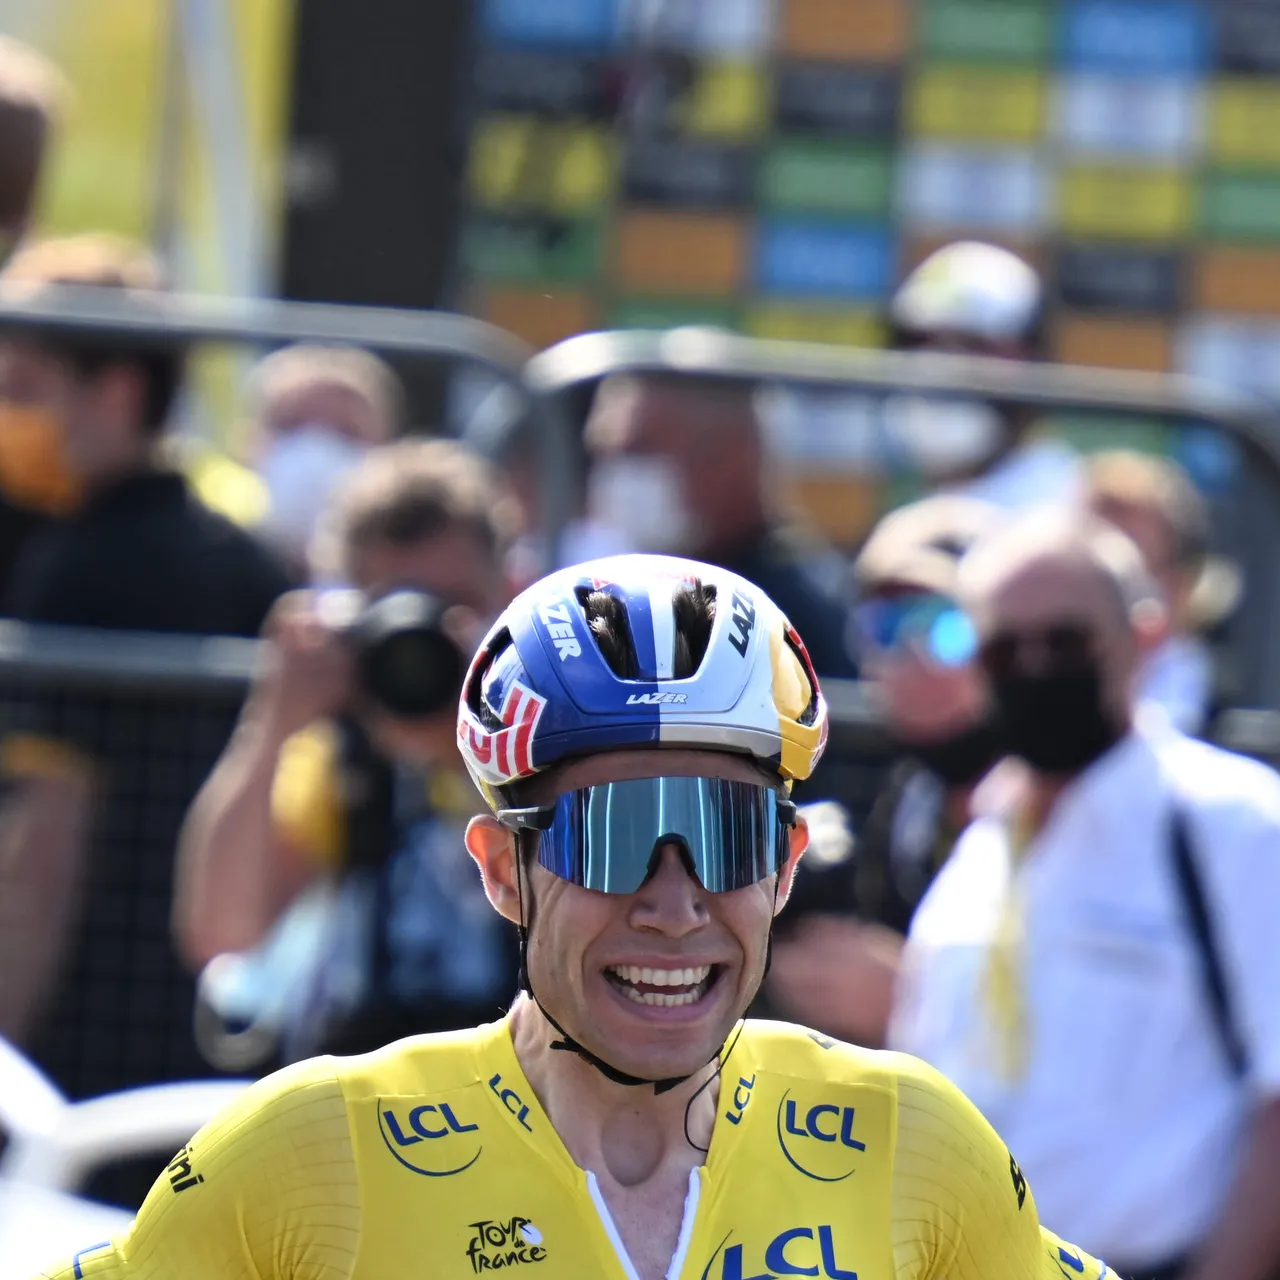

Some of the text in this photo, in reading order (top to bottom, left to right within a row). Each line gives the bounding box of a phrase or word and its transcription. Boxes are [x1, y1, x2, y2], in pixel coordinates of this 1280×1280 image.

[625, 692, 688, 705] LAZER
[383, 1102, 479, 1146] LCL
[489, 1073, 533, 1133] LCL
[725, 1073, 756, 1125] LCL
[785, 1100, 867, 1152] LCL
